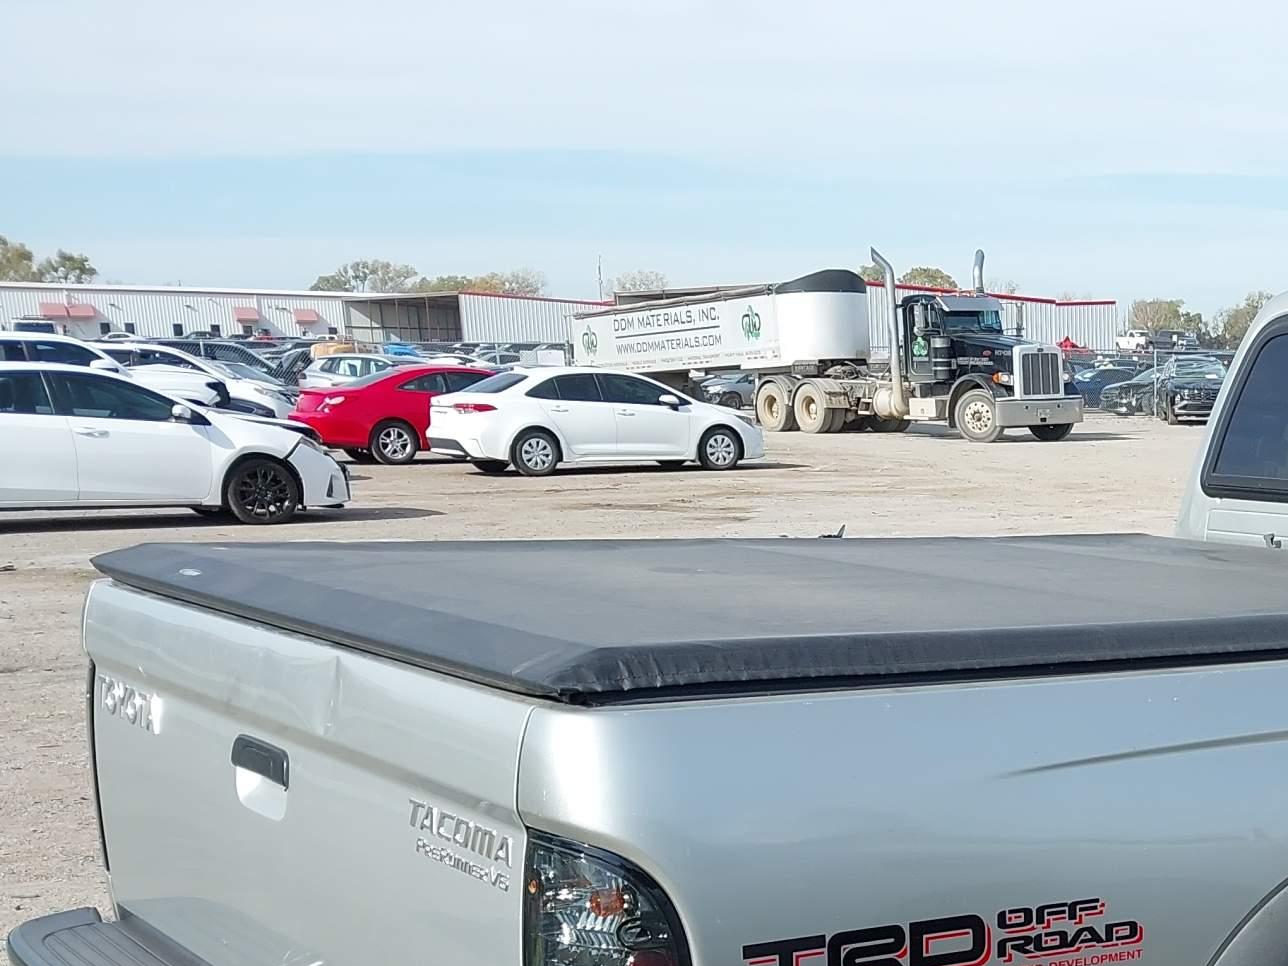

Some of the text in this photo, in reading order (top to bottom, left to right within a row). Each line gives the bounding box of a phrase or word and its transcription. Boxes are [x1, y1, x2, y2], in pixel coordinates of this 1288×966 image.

[637, 309, 696, 329] MATERIALS,
[698, 306, 720, 322] INC.
[409, 798, 512, 868] TACOMA
[488, 865, 510, 892] V6
[996, 897, 1105, 934] OFF
[996, 920, 1144, 962] ROAD
